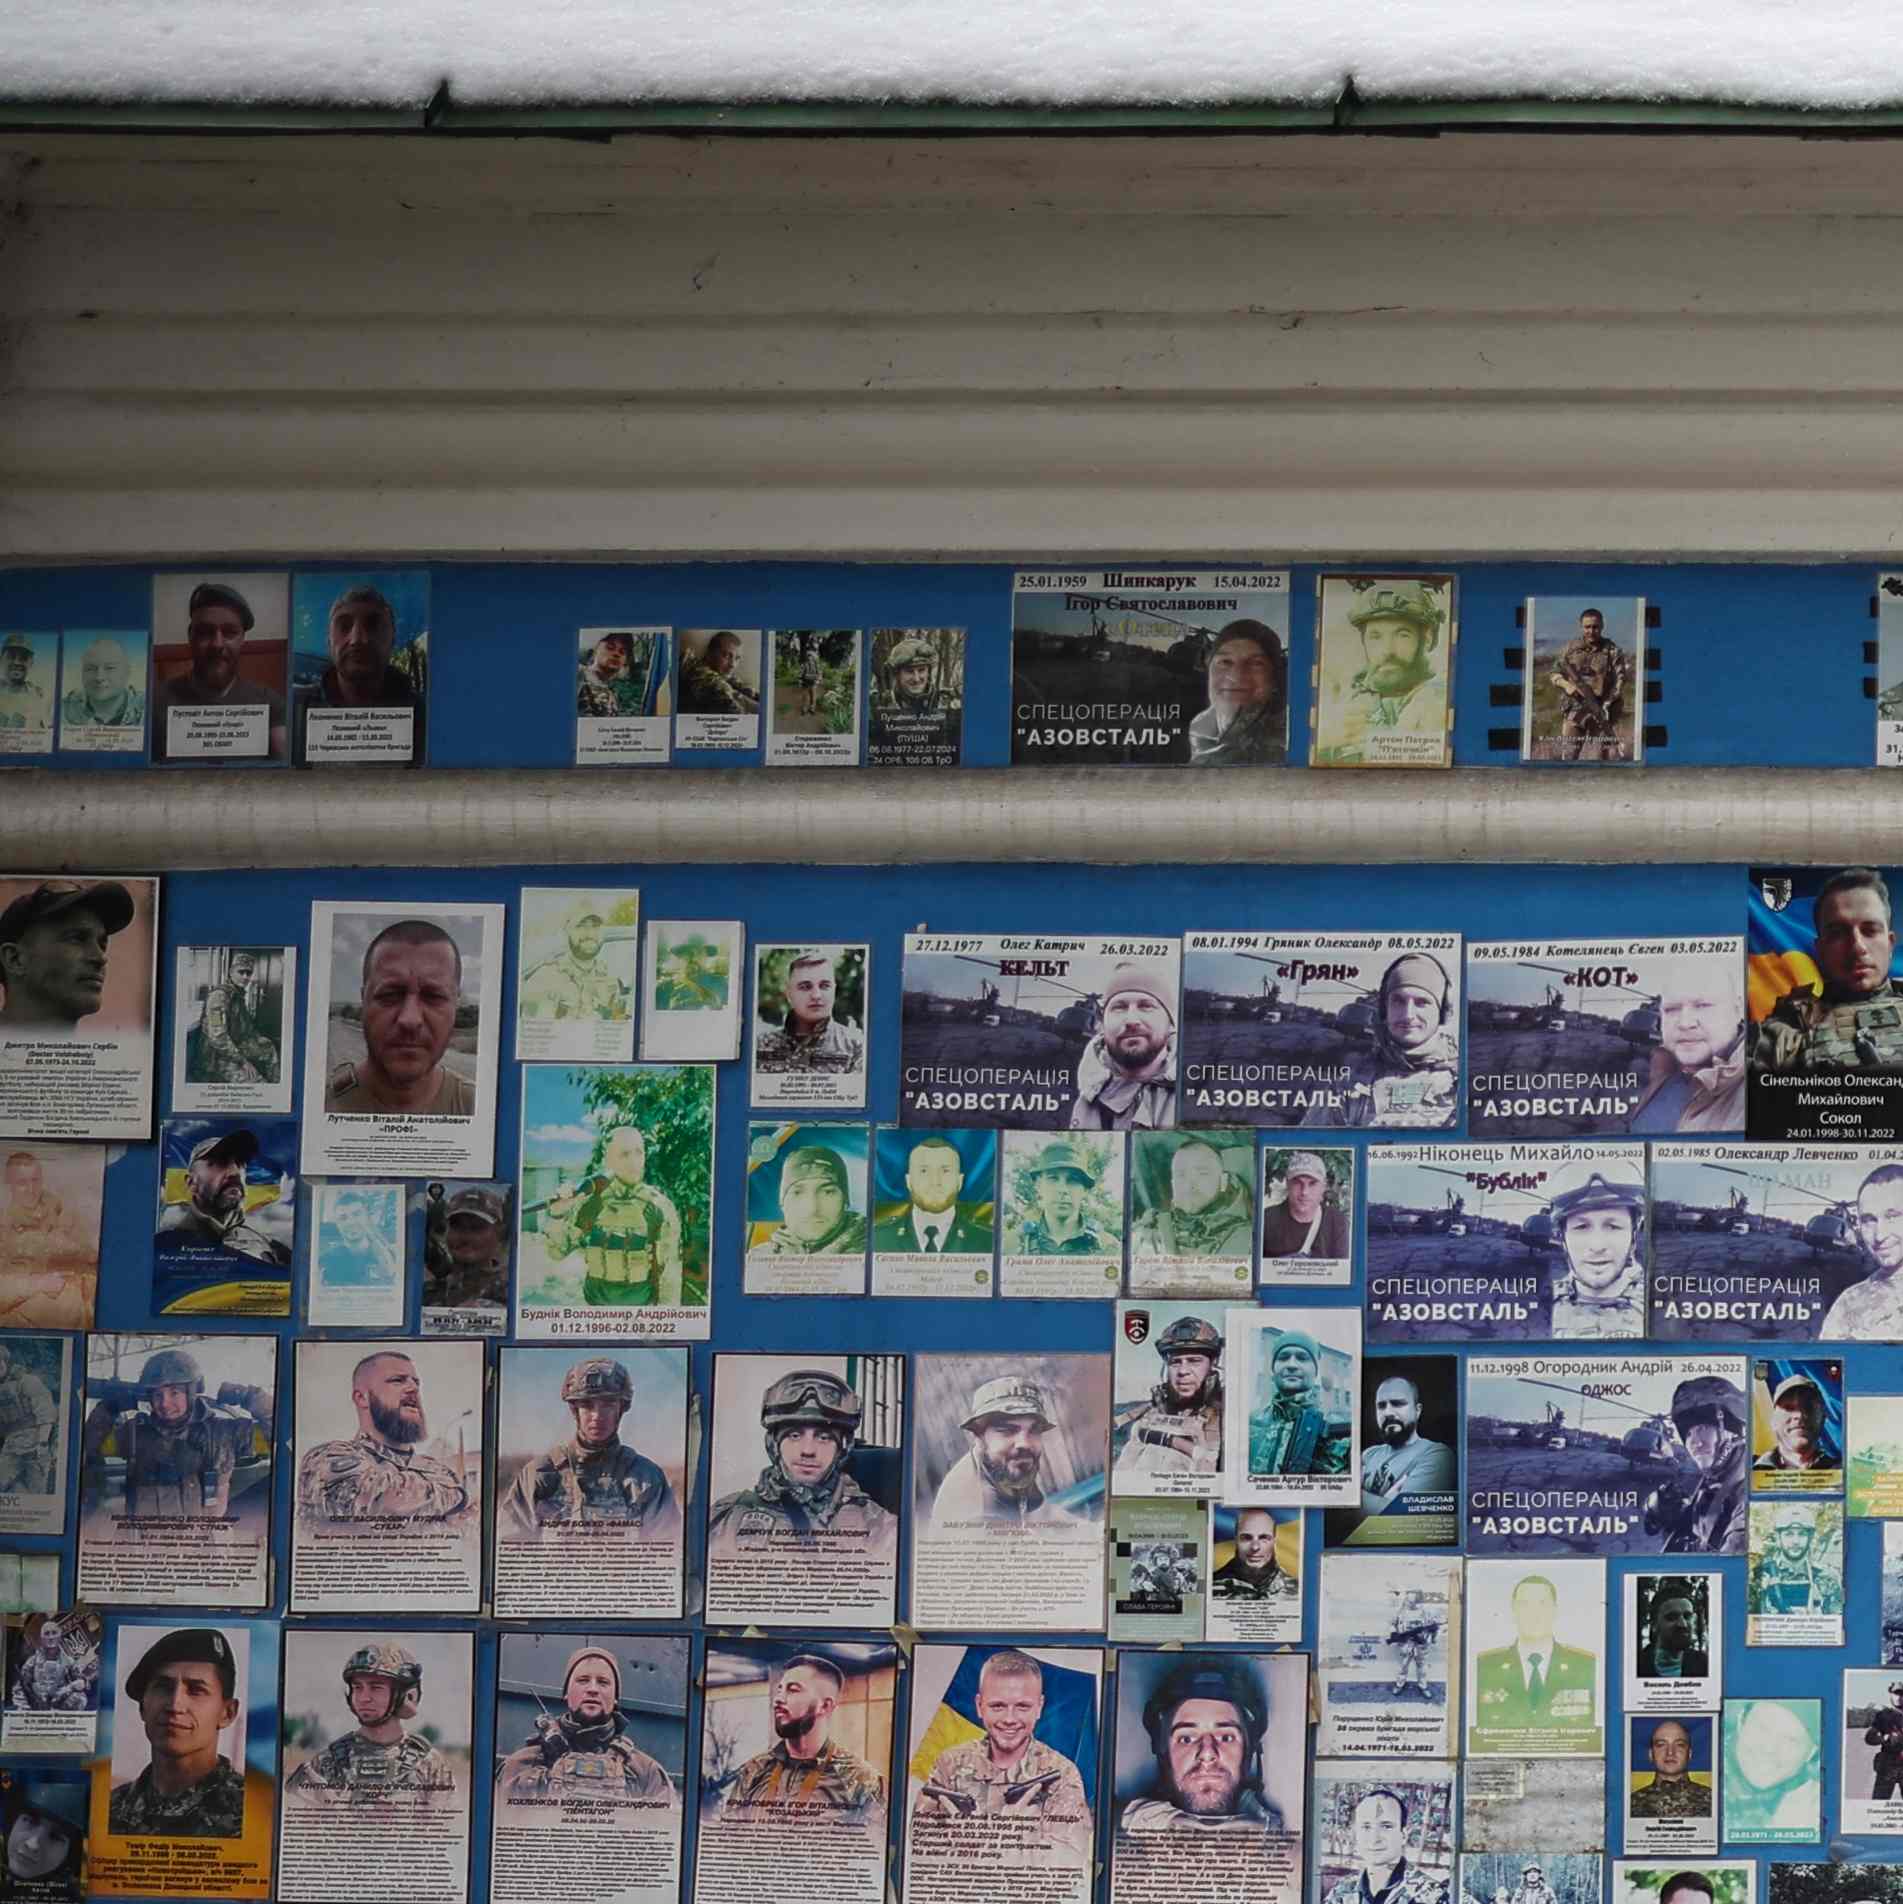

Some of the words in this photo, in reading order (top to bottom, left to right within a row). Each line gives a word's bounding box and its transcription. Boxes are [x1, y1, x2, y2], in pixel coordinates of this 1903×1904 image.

[1019, 575, 1087, 588] 25.01.1959
[1104, 573, 1196, 591] Шинкарук
[1214, 575, 1281, 588] 15.04.2022
[1065, 597, 1100, 613] Ігор
[1106, 597, 1239, 611] Святославович
[1016, 703, 1180, 722] СПЕЦОПЕРАЦІЯ
[1017, 728, 1181, 746] "АЗОВСТАЛЬ"
[916, 940, 983, 951] 27.12.1977
[1000, 939, 1031, 950] Олег
[1033, 939, 1085, 951] Катрич
[1100, 943, 1168, 956] 26.03.2022
[1192, 937, 1258, 949] 08.01.1994
[1264, 937, 1311, 950] Гряник
[1315, 937, 1382, 951] Олександр
[1388, 938, 1455, 949] 08.05.2022
[1474, 946, 1540, 959] 09.05.1984
[1546, 945, 1624, 958] Котелянець
[1628, 942, 1665, 955] Євген
[1670, 942, 1737, 954] 03.05.2022
[1277, 959, 1359, 984] «Грян»
[1563, 966, 1639, 988] «КОТ»
[905, 1067, 1070, 1087] СПЕЦОПЕРАЦІЯ
[1186, 1064, 1350, 1083] СПЕЦОПЕРАЦІЯ
[1473, 1072, 1638, 1093] СПЕЦОПЕРАЦІЯ
[1760, 1074, 1841, 1087] Сінельніков
[905, 1092, 1070, 1111] "АЗОВСТАЛЬ"
[1473, 1096, 1639, 1117] "АЗОВСТАЛЬ"
[1798, 1092, 1884, 1106] Михайлович
[1819, 1111, 1862, 1124] Сокол
[1786, 1128, 1895, 1138] 24.01.1998-30.11.2022
[1368, 1151, 1418, 1161] 16.06.1992
[1419, 1147, 1504, 1165] Ніконець
[1510, 1145, 1594, 1161] Михайло
[1595, 1150, 1644, 1159] 14.05.2022
[1658, 1148, 1710, 1158] 02.05.1985
[1715, 1147, 1789, 1162] Олександр
[1792, 1148, 1858, 1160] Левченко
[1466, 1172, 1547, 1193] "Бублік"
[1372, 1277, 1537, 1298] СПЕЦОПЕРАЦІЯ
[1655, 1276, 1820, 1295] СПЕЦОПЕРАЦІЯ
[521, 1309, 560, 1320] Буднік
[564, 1309, 632, 1320] Володимир
[635, 1309, 707, 1320] Андрійович
[1372, 1302, 1539, 1322] "АЗОВСТАЛЬ"
[1654, 1302, 1821, 1320] "АЗОВСТАЛЬ"
[551, 1324, 675, 1333] 01.12.1996-02.08.2022
[1471, 1361, 1529, 1376] 11.12.1998
[1534, 1362, 1617, 1377] Огородник
[1622, 1360, 1673, 1376] Андрій
[1680, 1363, 1742, 1375] 26.04.2022
[1472, 1491, 1638, 1510] СПЕЦОПЕРАЦІЯ
[1472, 1516, 1639, 1536] "АЗОВСТАЛЬ"
